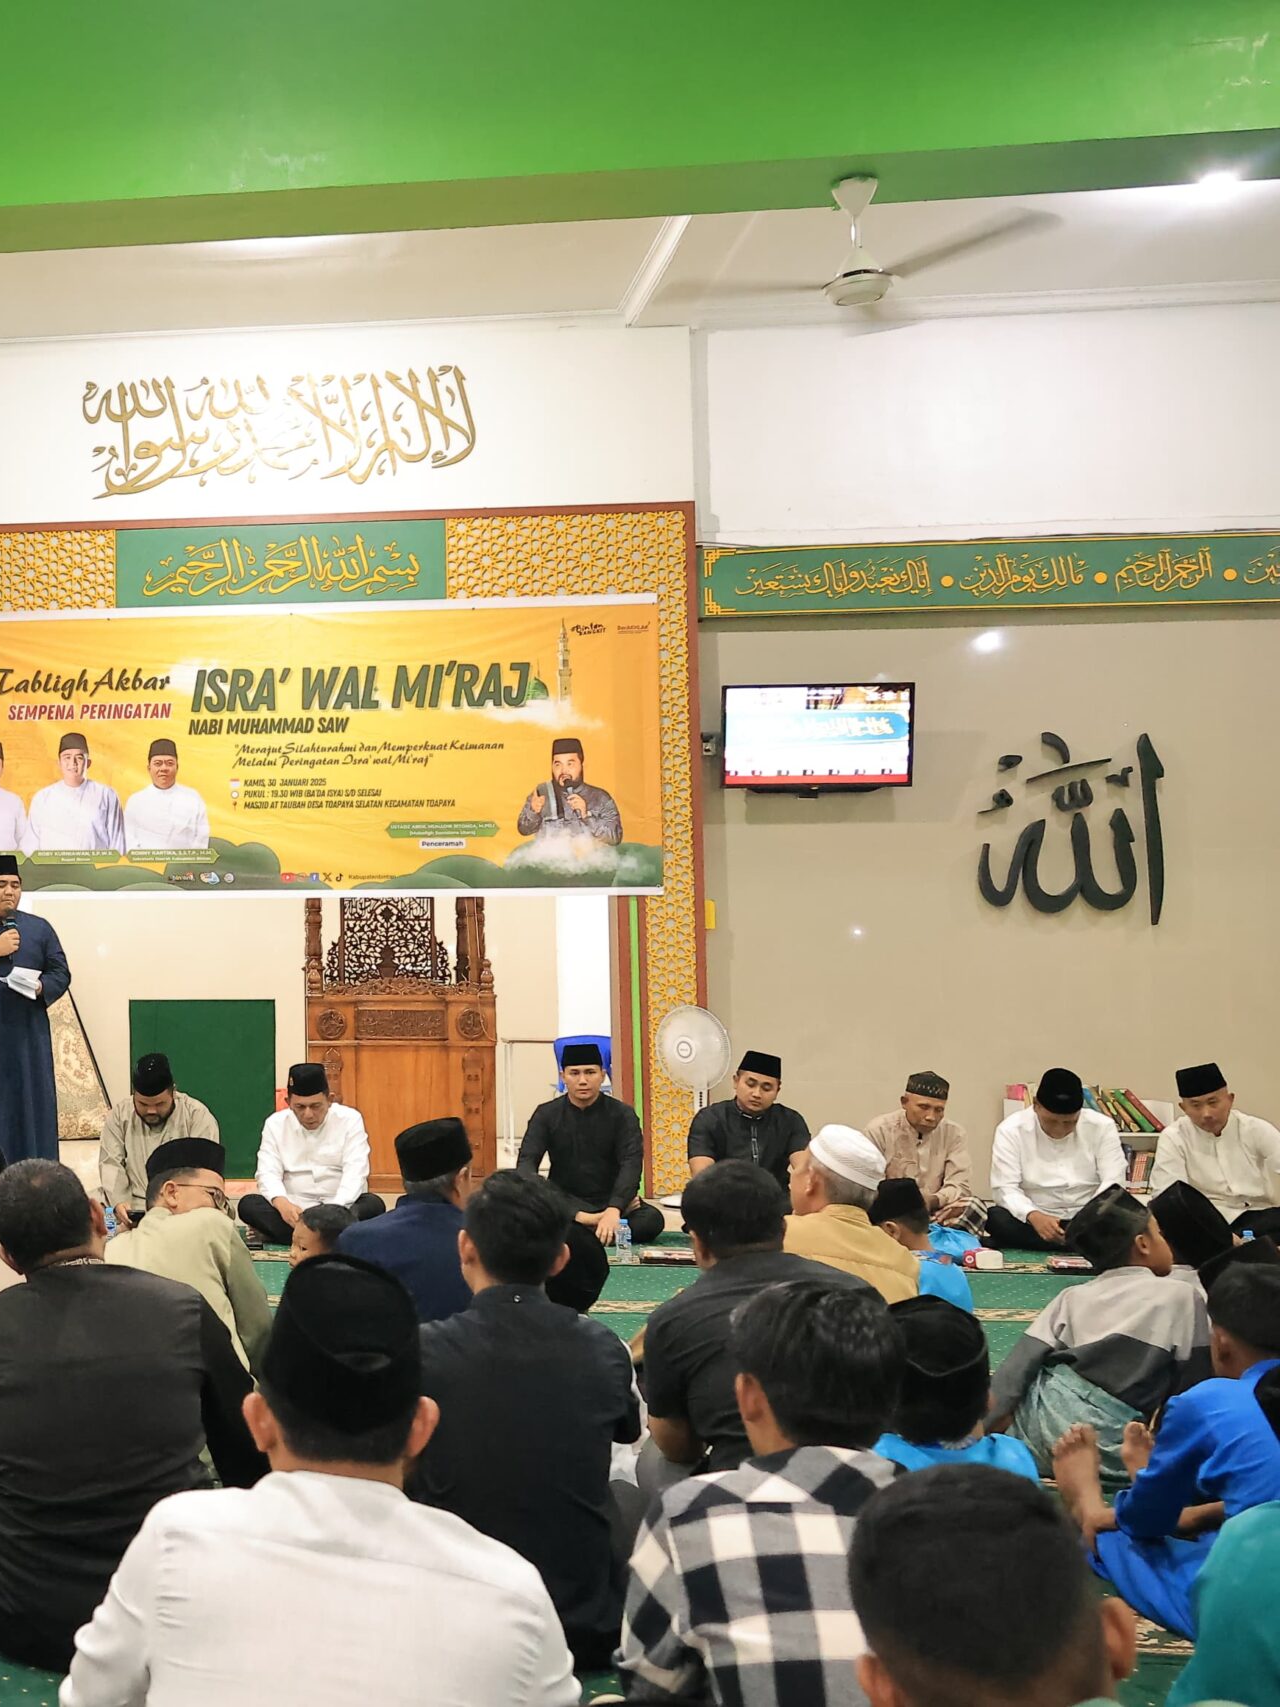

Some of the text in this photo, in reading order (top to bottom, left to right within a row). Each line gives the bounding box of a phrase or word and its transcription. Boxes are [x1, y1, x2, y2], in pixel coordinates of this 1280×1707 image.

[89, 667, 171, 698] Akbar
[301, 665, 381, 711] WAL
[8, 702, 172, 721] SEMPENA PERINGATAN
[188, 716, 350, 736] NABI MUHAMMAD SAW
[377, 740, 448, 755] Memperkuat
[449, 739, 505, 751] Keimanan
[231, 756, 277, 770] Melalui
[280, 754, 340, 770] Peringatan
[267, 778, 277, 787] 30
[279, 778, 309, 787] JANUARI
[310, 778, 327, 787] 2025
[243, 789, 266, 798] PUKUL
[271, 789, 289, 798] 19.30
[289, 789, 303, 798] WIB
[356, 788, 382, 797] SELESAI
[243, 799, 456, 809] MASJID AT TAUBAH DESA TOAPAYA SELATAN KECAMATAN TOAPAYA
